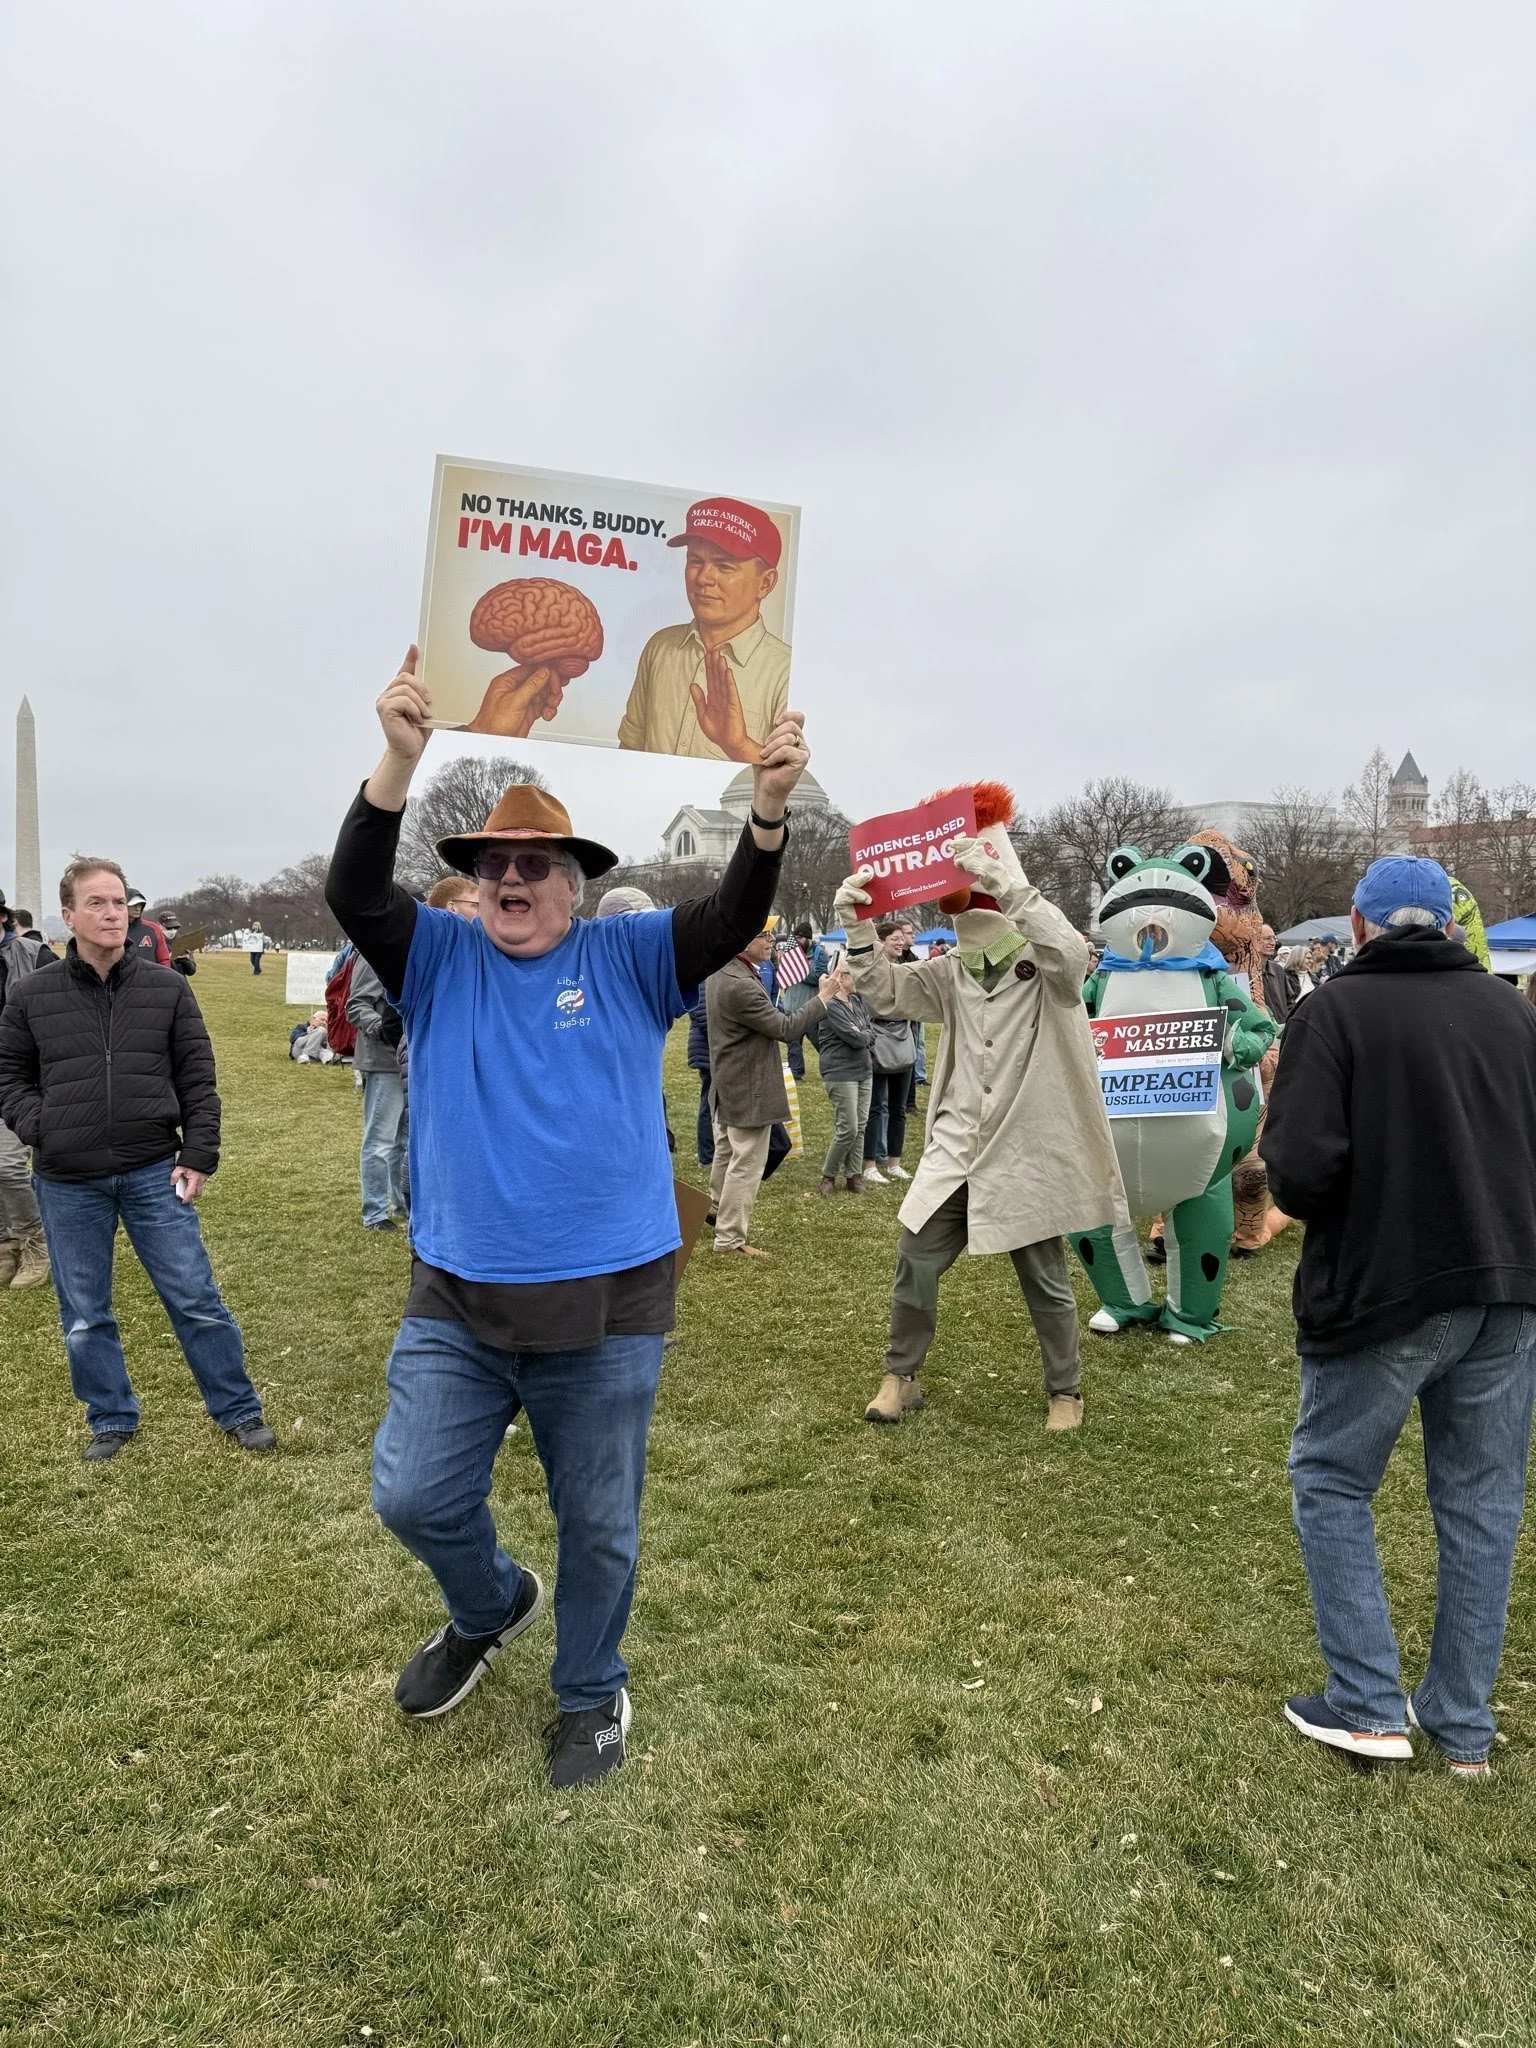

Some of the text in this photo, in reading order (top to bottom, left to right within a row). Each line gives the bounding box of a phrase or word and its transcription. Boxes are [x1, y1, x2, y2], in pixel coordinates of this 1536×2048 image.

[461, 493, 667, 538] NO THANKS, BUDDY.
[691, 508, 757, 536] MAKE AMERICA
[693, 518, 752, 543] GREAT AGAIN
[458, 516, 638, 571] I'M MAGA.
[855, 816, 965, 861] EVIDENCE-BASED
[1112, 1018, 1218, 1040] NO PUPPET
[1124, 1034, 1218, 1053] MASTERS.
[1100, 1070, 1215, 1094] IMPEACH
[1105, 1091, 1212, 1106] USSELL VOUGHT.
